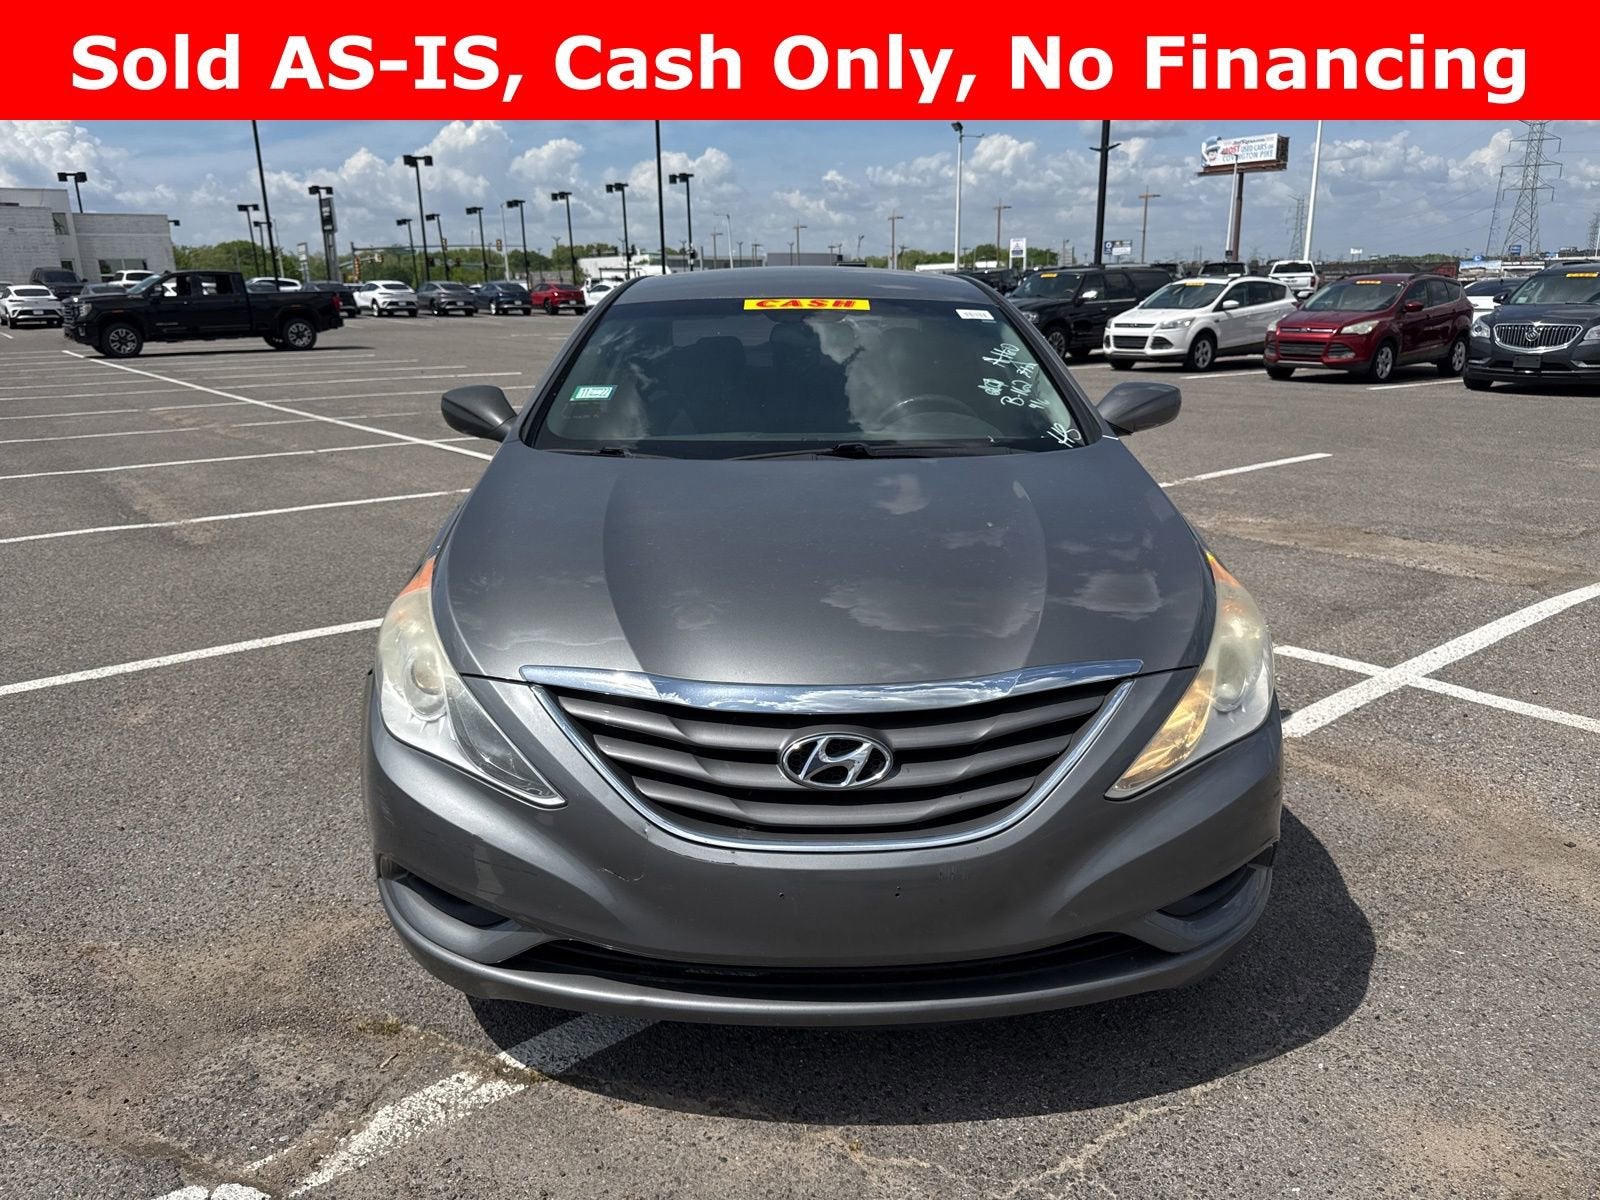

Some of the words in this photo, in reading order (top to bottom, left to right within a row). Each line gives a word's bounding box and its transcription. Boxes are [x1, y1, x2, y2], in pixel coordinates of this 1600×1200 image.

[1254, 143, 1267, 151] CARS
[1222, 153, 1259, 162] COVNGTON
[1260, 150, 1273, 158] PIKE
[756, 299, 855, 308] CASH
